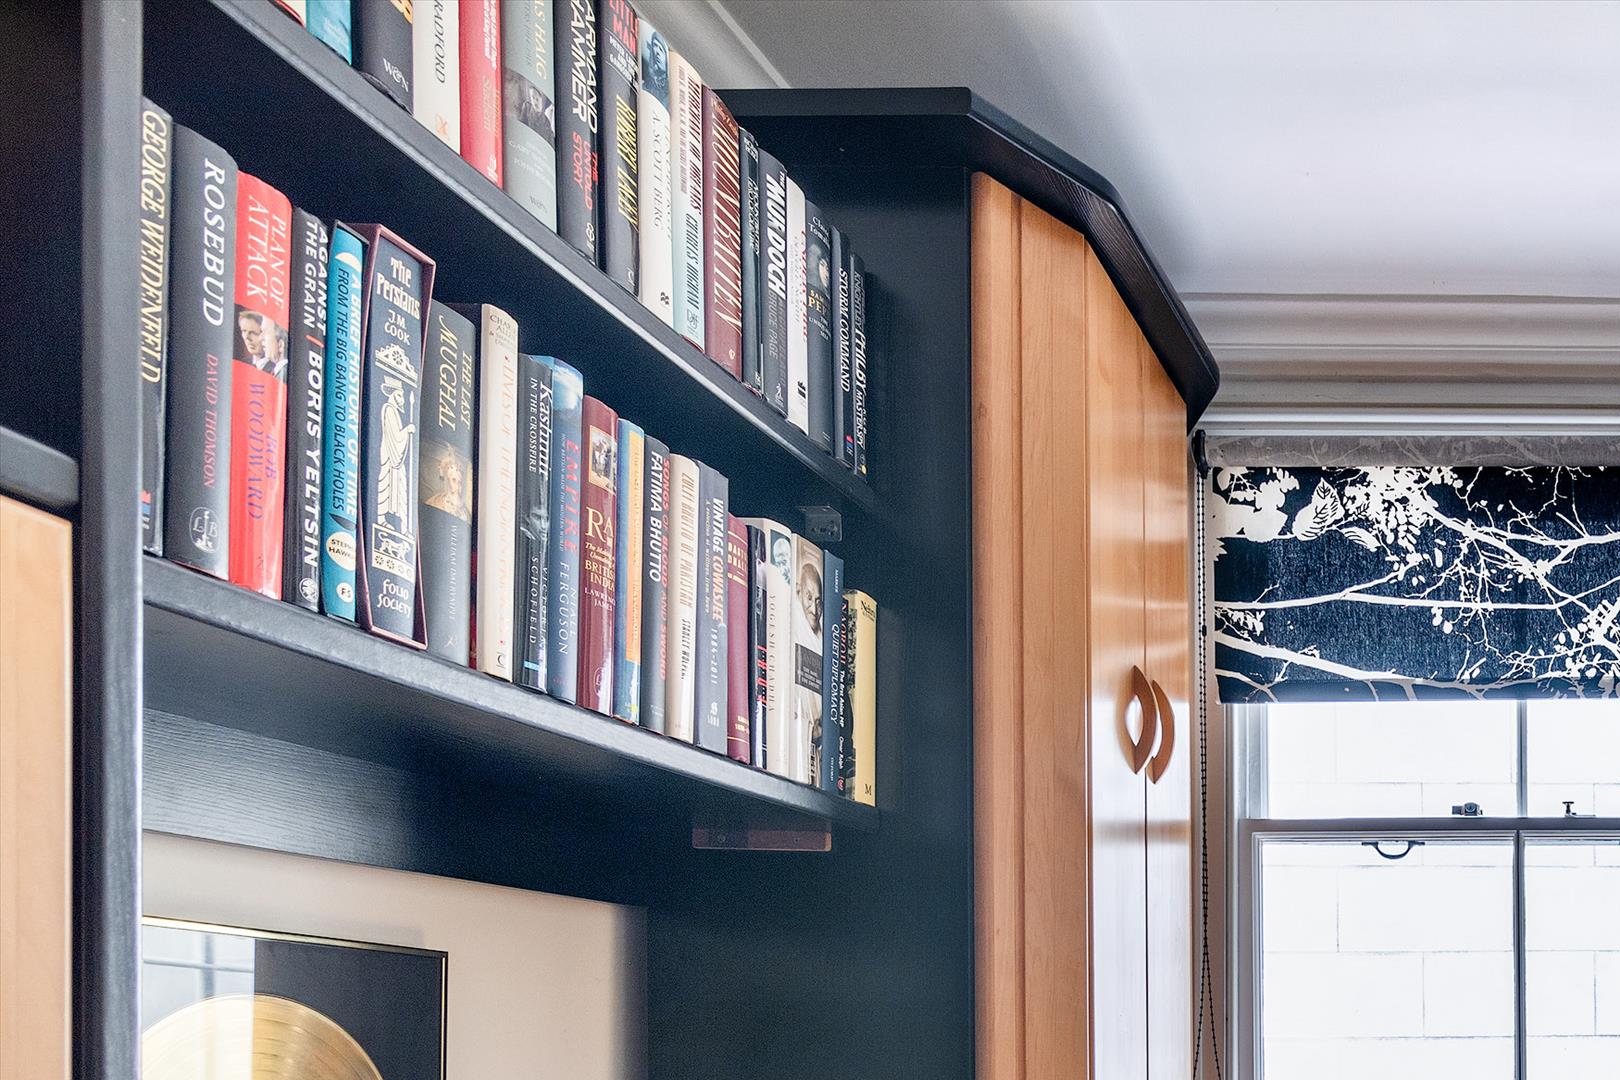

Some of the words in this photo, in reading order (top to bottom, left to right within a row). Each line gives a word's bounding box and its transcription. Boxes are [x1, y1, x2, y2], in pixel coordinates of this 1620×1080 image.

[584, 0, 598, 134] ARMAND
[141, 110, 167, 219] GEORGE
[572, 131, 583, 189] STORY
[584, 141, 593, 210] UNTOLD
[202, 158, 226, 326] ROSEBUD
[246, 195, 270, 305] ATTACK
[304, 220, 319, 261] THE
[766, 173, 786, 301] MURDOCH
[140, 217, 165, 383] WEIDENFELD
[303, 264, 318, 328] GRAIN
[315, 226, 329, 335] AGAINST
[336, 267, 350, 307] FROM
[390, 256, 413, 288] The
[839, 268, 849, 319] STORM
[337, 311, 349, 337] THE
[350, 291, 362, 345] BRIEF
[384, 324, 411, 345] COOK
[768, 330, 778, 360] PAGE
[205, 353, 219, 405] DAVID
[336, 339, 348, 363] BIG
[438, 314, 459, 432] MUGHAL
[462, 350, 472, 384] THE
[840, 319, 850, 392] COMMAND
[855, 327, 867, 396] PHILBY
[306, 350, 323, 440] BORIS
[335, 364, 348, 400] BANG
[347, 350, 361, 428] HISTORY
[461, 386, 471, 432] LAST
[530, 377, 538, 389] IN
[530, 393, 538, 419] THE
[335, 402, 346, 422] TO
[538, 381, 553, 480] Kashmir
[203, 406, 218, 488] THOMSON
[333, 424, 346, 465] BLACK
[347, 433, 359, 463] OF
[528, 420, 537, 472] CROSSFIRE
[304, 448, 321, 567] YELTSIN
[332, 469, 345, 511] HOLES
[345, 466, 357, 516] TIME
[650, 451, 663, 512] FATIMA
[661, 458, 670, 511] SONGS
[649, 516, 662, 582] BHUTTO
[712, 497, 724, 556] VINTAGE
[585, 559, 615, 580] BRITIS
[529, 555, 539, 644] SCHOFIELD
[558, 561, 570, 655] FERGUSON
[831, 623, 840, 656] QUIET
[830, 658, 839, 725] DIPLOMACY
